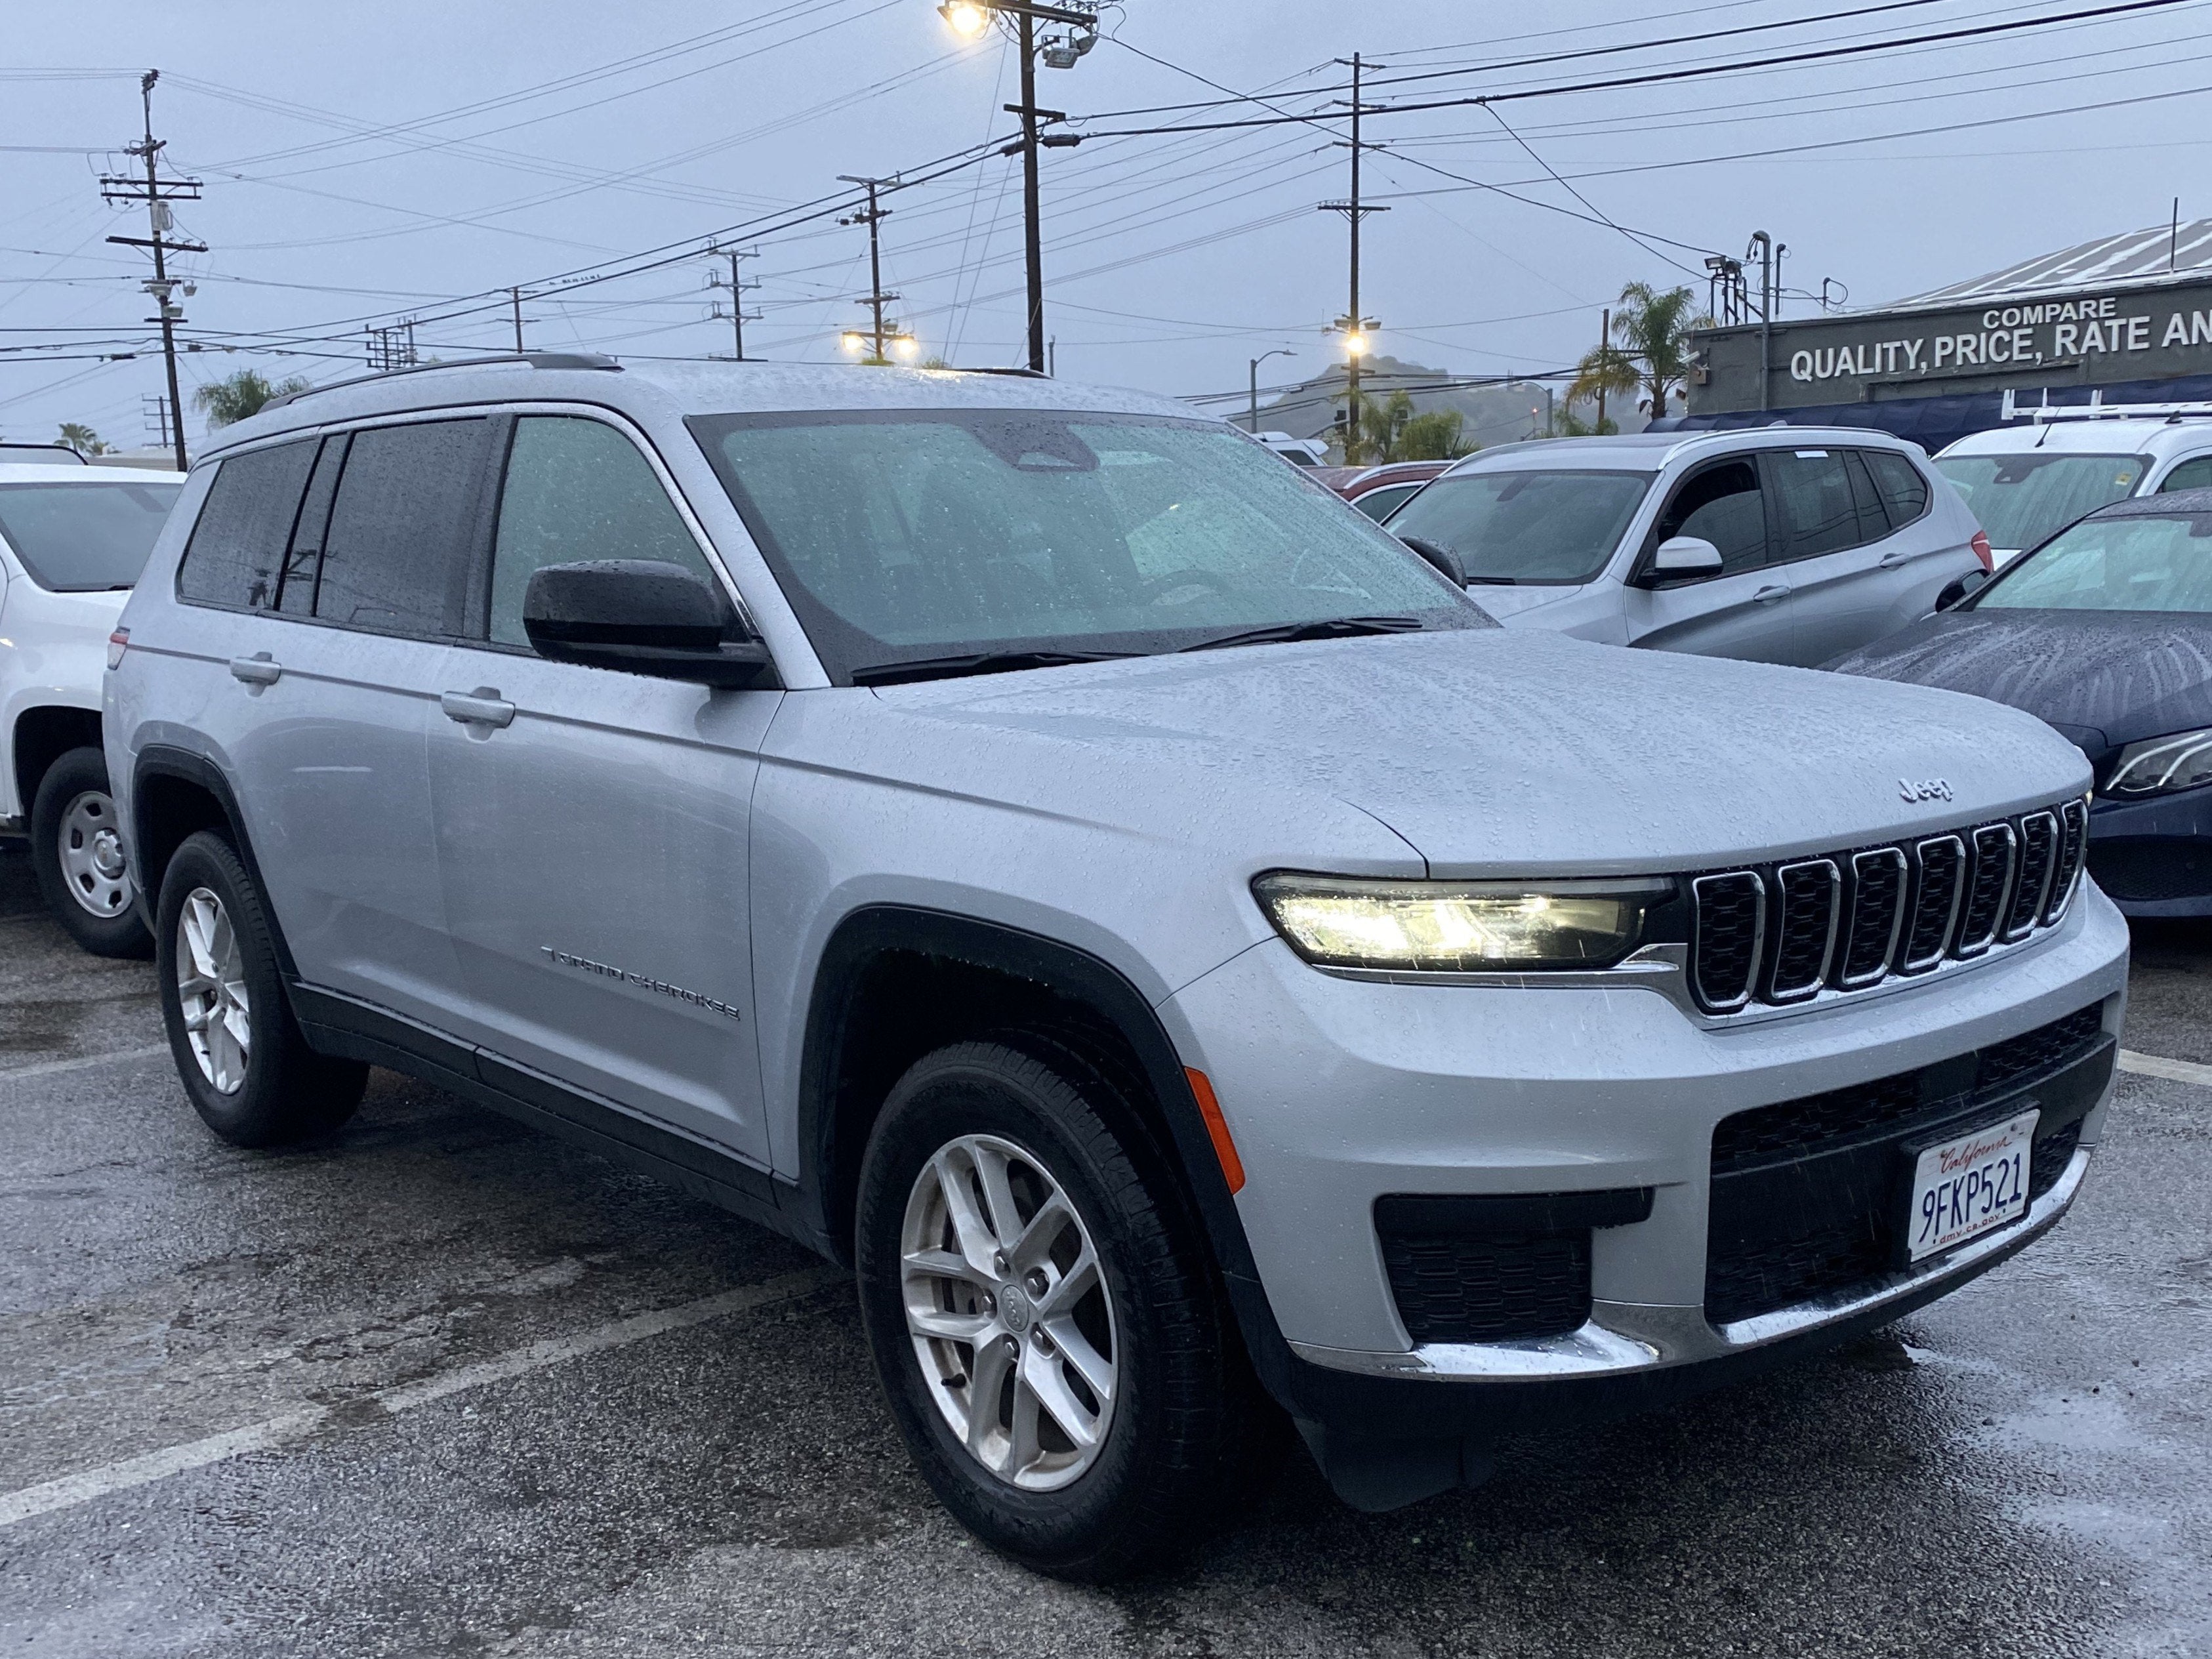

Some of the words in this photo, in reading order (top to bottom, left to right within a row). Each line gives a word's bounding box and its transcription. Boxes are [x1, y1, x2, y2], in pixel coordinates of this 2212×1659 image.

[1982, 297, 2117, 329] COMPARE
[1790, 338, 1929, 382] QUALITY,
[1935, 327, 2043, 368] PRICE,
[2055, 316, 2151, 357] RATE
[1898, 777, 1954, 804] Jeep
[627, 972, 741, 1021] CHEROKEE
[1940, 1136, 2013, 1174] California
[1917, 1153, 2022, 1243] 9FKP521
